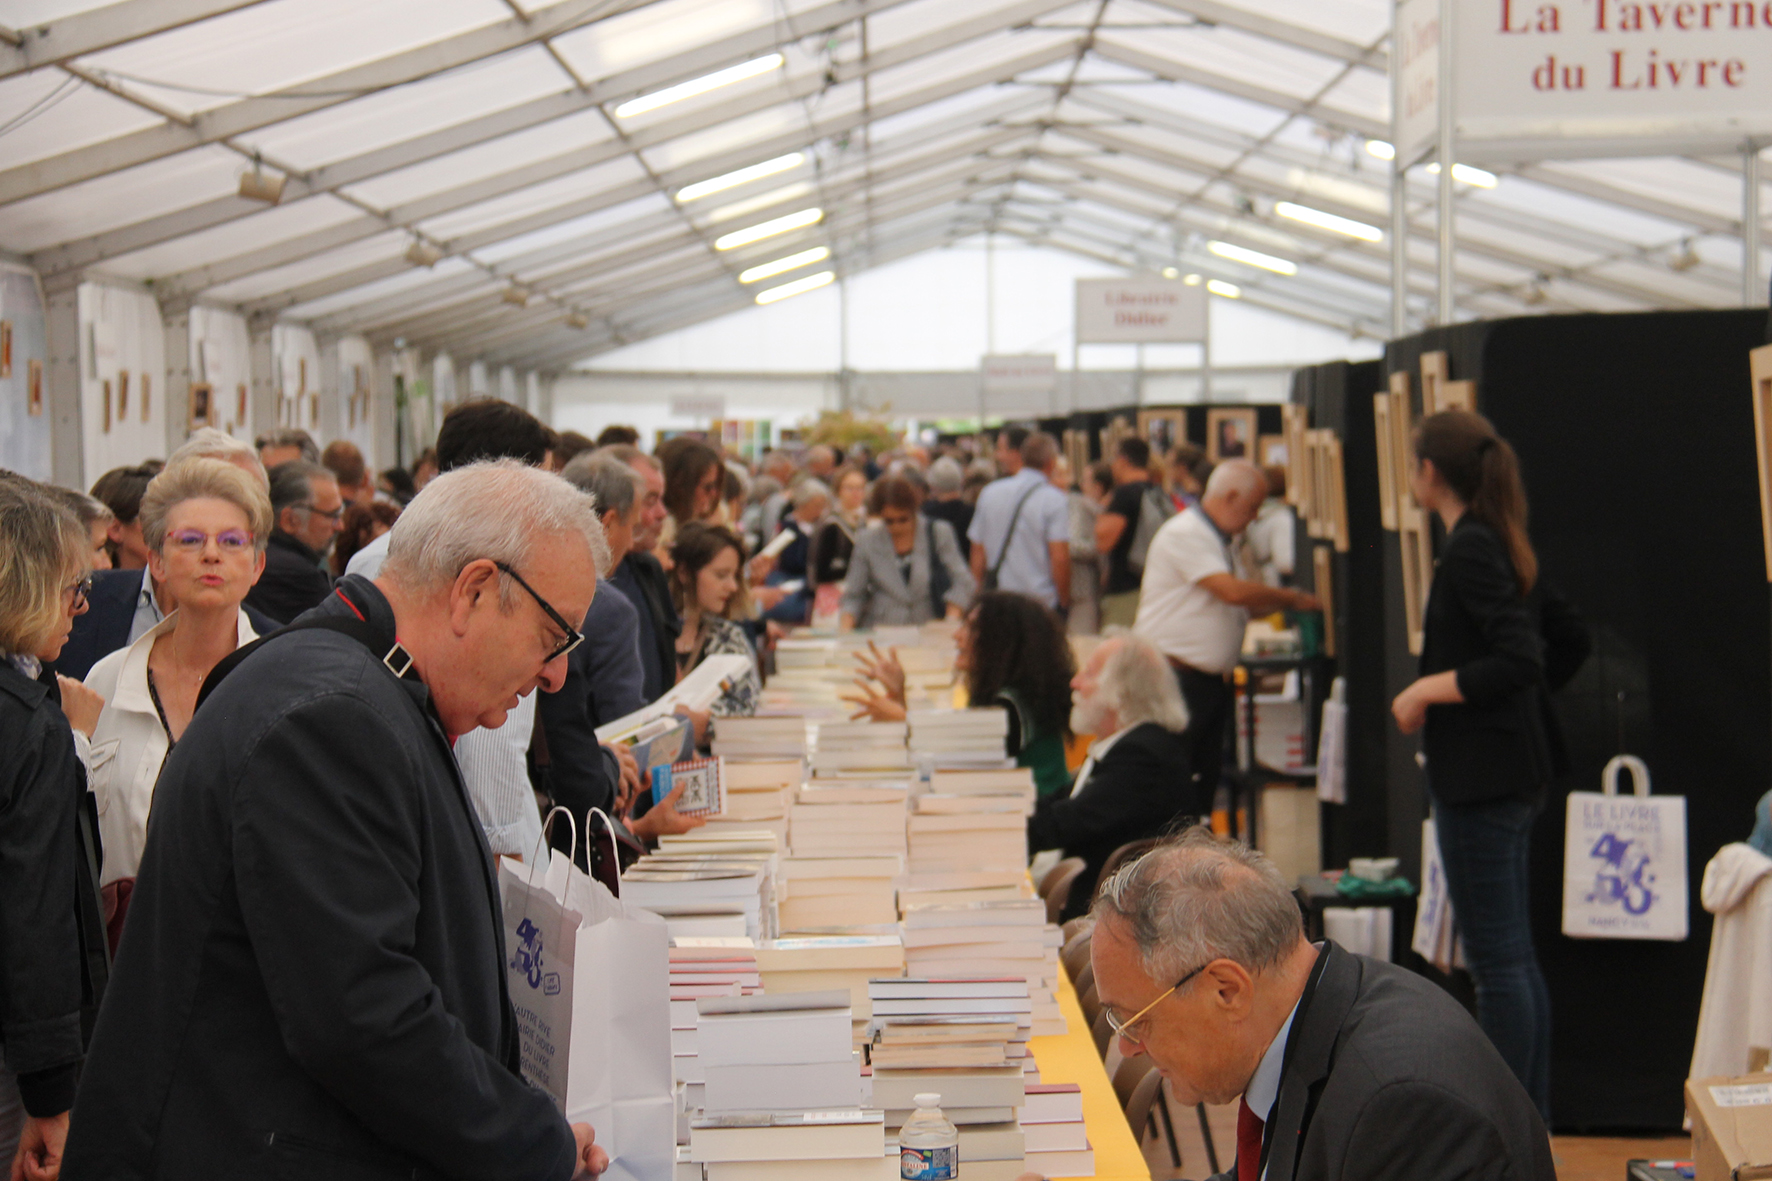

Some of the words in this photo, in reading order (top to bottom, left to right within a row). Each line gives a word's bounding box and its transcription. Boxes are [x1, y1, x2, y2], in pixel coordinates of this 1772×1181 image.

[1498, 0, 1562, 34] La
[1531, 54, 1587, 91] du
[1610, 49, 1746, 90] Livre
[1609, 803, 1660, 821] LIVRE
[514, 1003, 538, 1027] 'AUTRE
[518, 1023, 535, 1041] AIRIE
[523, 1041, 533, 1056] DU
[534, 1049, 549, 1070] LIVRE
